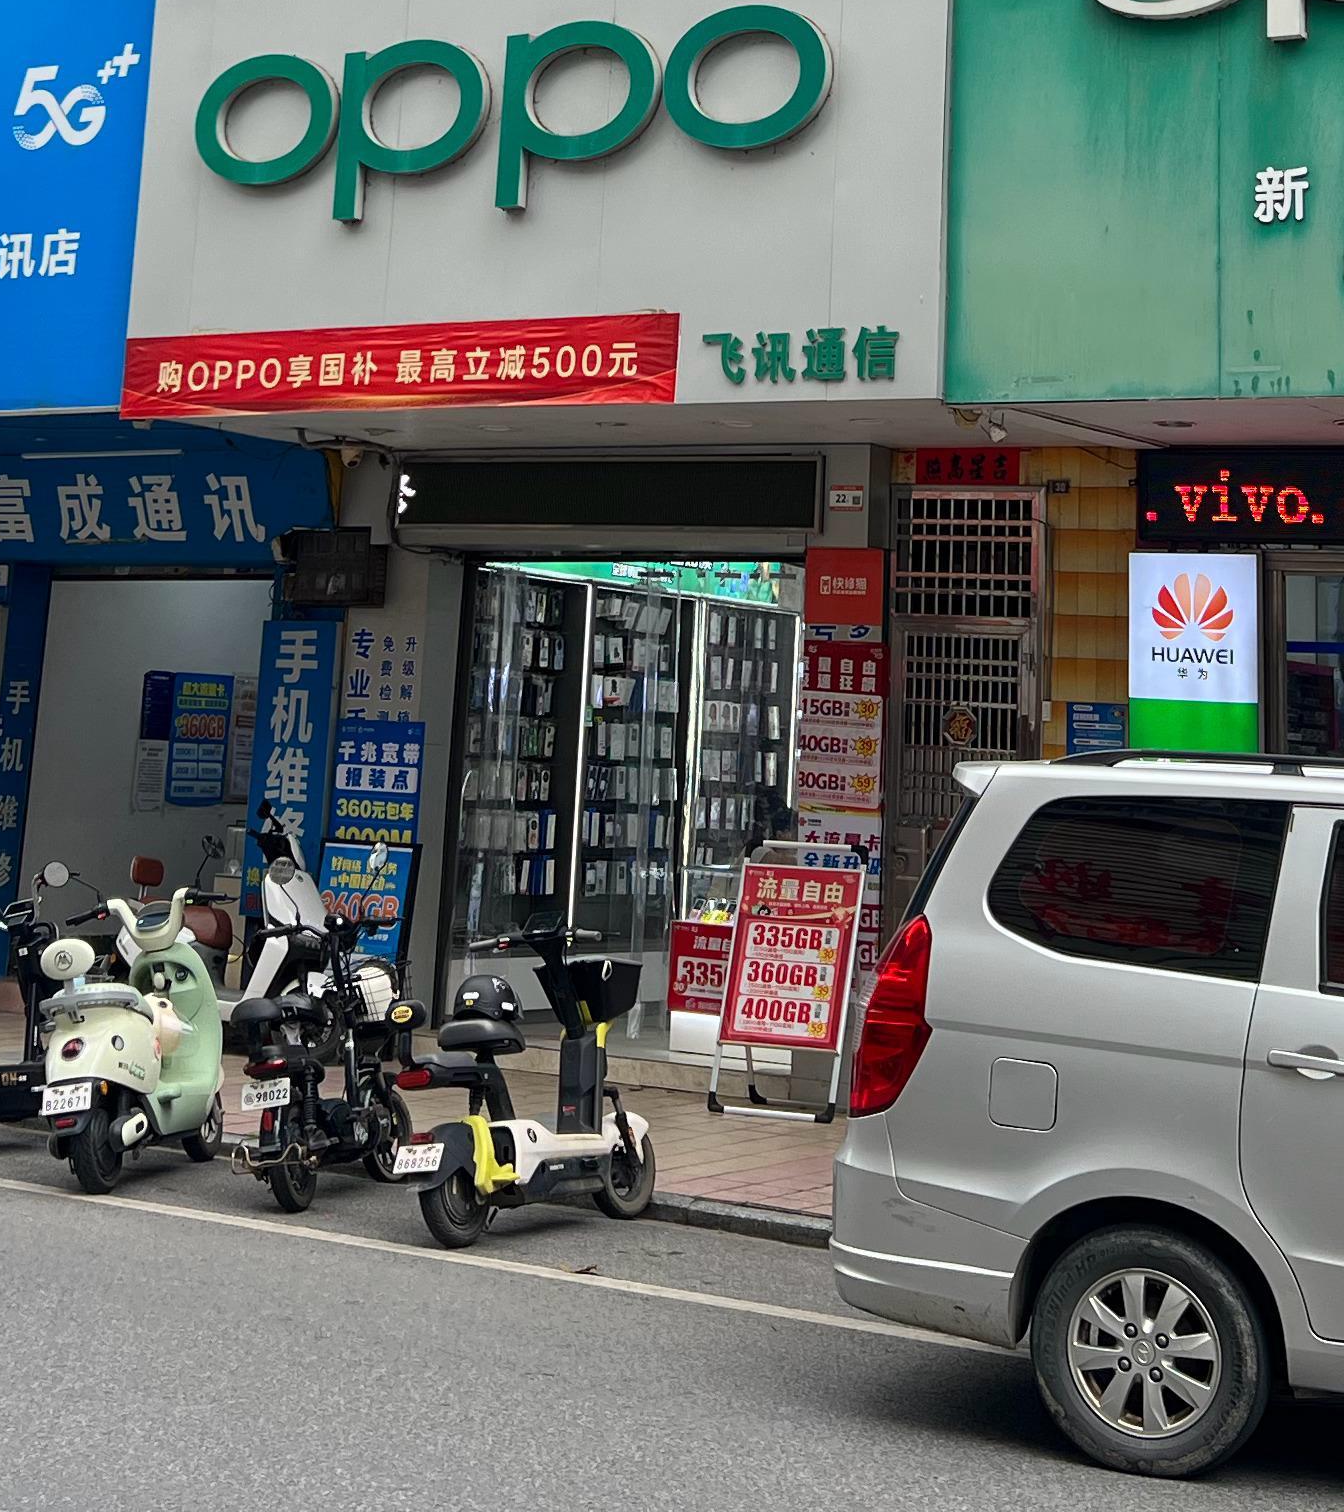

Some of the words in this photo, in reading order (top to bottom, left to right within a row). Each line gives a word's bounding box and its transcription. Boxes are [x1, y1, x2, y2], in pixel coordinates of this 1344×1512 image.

[195, 4, 834, 224] oppo
[157, 351, 379, 394] 购OPPO享国补
[396, 342, 639, 387] 最高立减500元
[702, 326, 900, 384] 飞讯通信
[835, 493, 847, 504] 22
[1150, 647, 1235, 665] HUAWEI
[1176, 668, 1210, 680] 华为
[337, 740, 422, 764] 千兆宽带
[343, 765, 410, 792] 报装点
[335, 798, 415, 821] 360元包年
[756, 877, 845, 905] 流量自由
[752, 924, 824, 950] 335GB
[746, 960, 818, 987] 360GB
[740, 996, 812, 1024] 400GB
